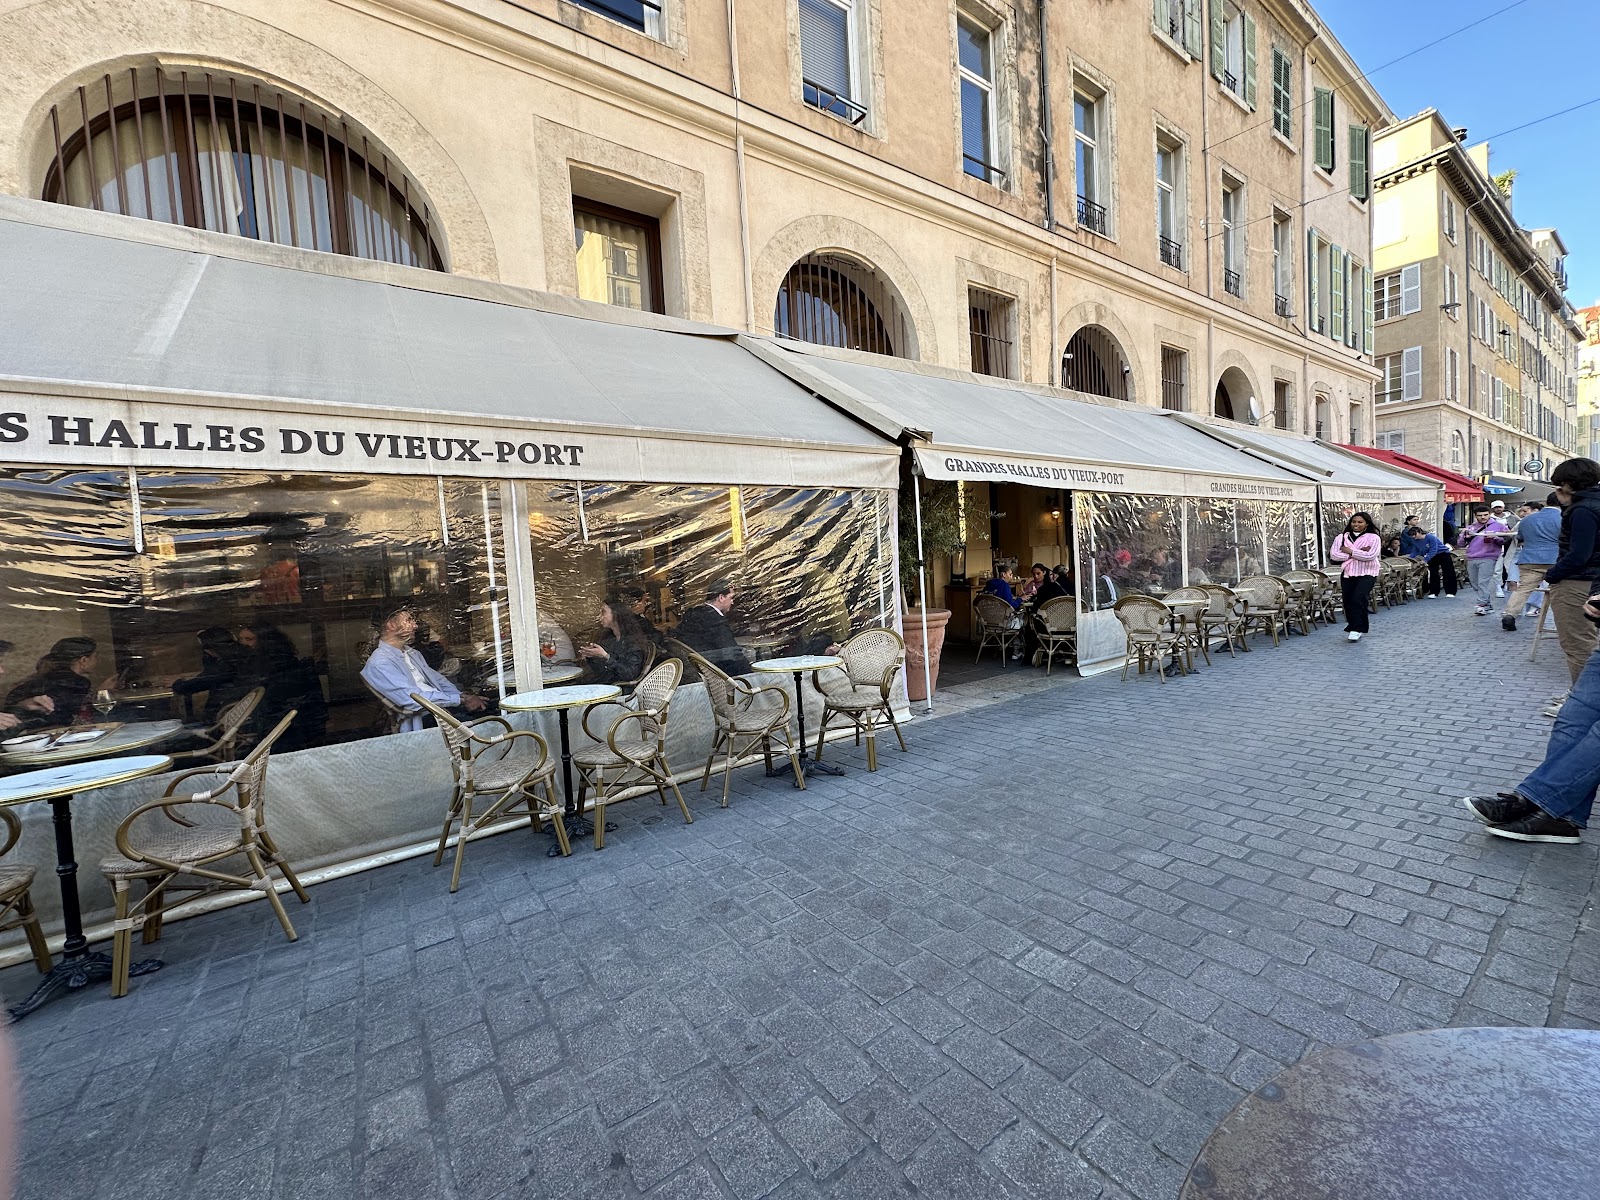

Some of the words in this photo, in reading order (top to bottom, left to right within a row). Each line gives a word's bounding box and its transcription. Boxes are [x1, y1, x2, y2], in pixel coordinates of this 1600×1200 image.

[48, 415, 265, 453] HALLES
[279, 428, 345, 456] DU
[355, 432, 584, 466] VIEUX-PORT
[944, 457, 1008, 474] GRANDES
[1006, 464, 1051, 480] HALLES
[1051, 467, 1067, 481] DU
[1067, 469, 1125, 485] VIEUX-PORT
[1210, 482, 1237, 493] GRANDES
[1237, 484, 1257, 494] HALLES
[1257, 485, 1265, 495] DU
